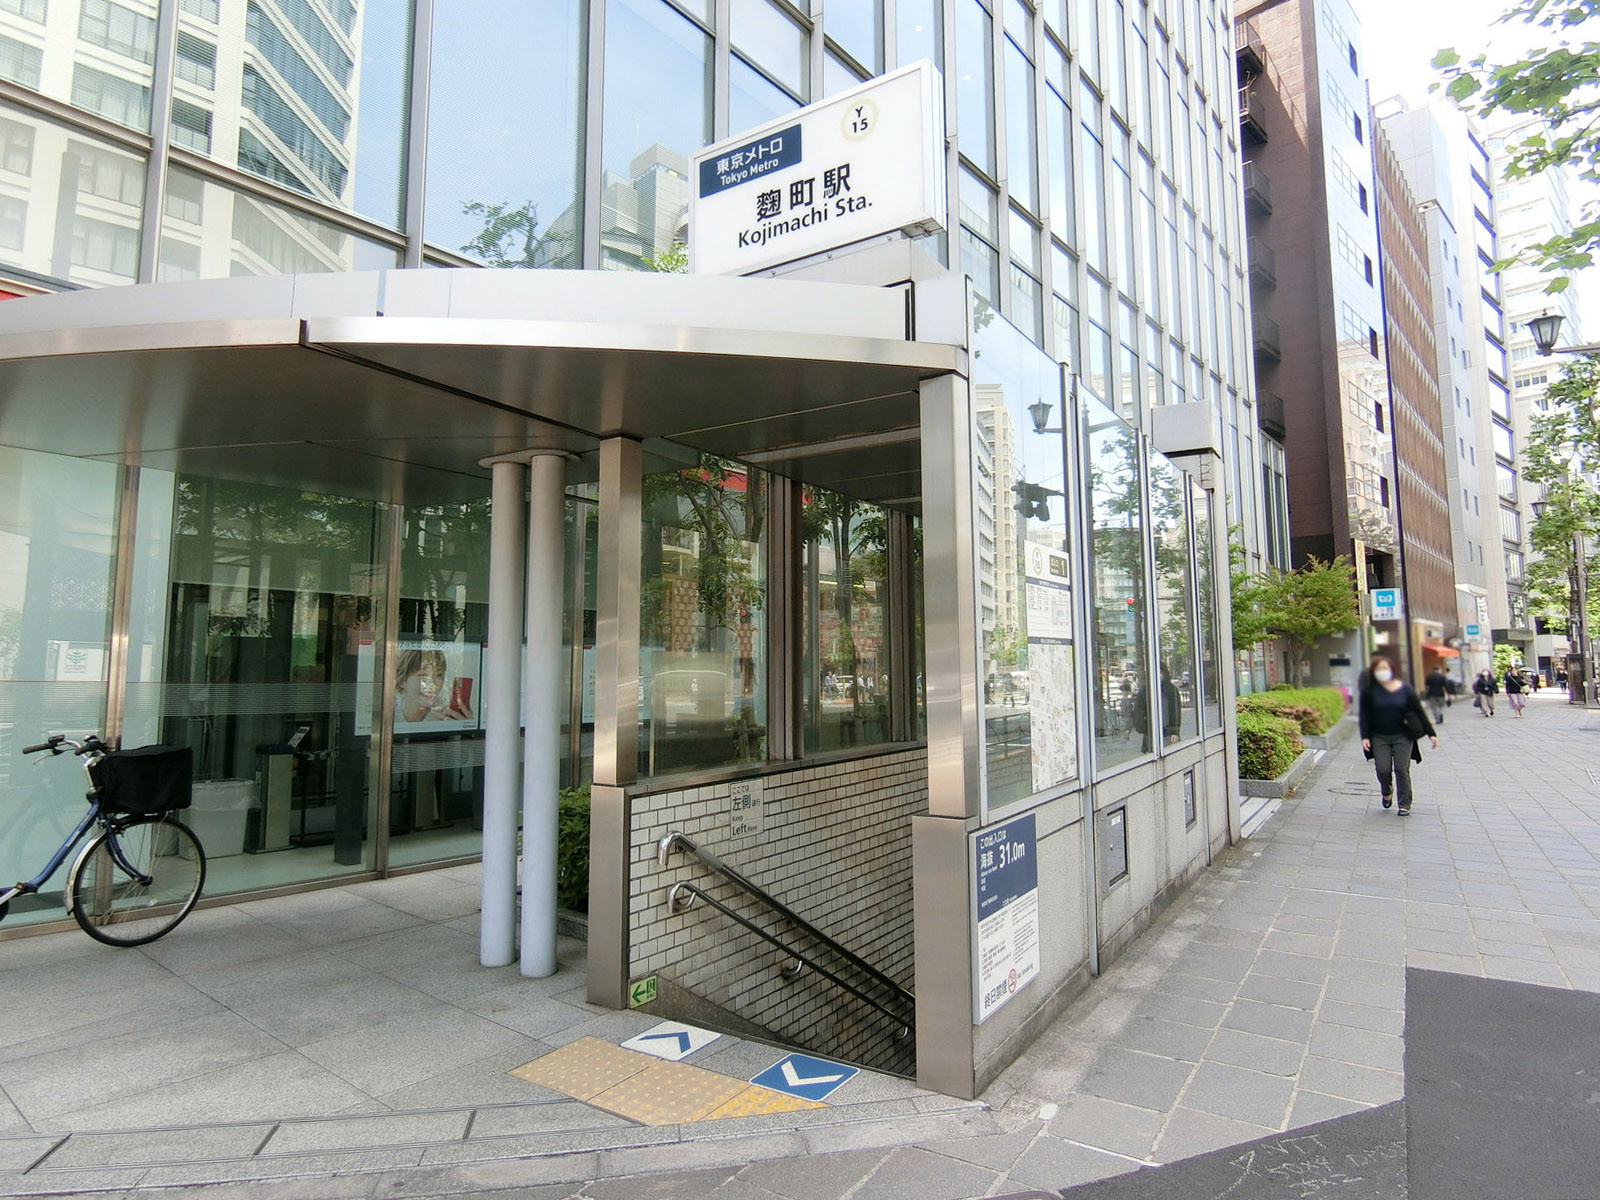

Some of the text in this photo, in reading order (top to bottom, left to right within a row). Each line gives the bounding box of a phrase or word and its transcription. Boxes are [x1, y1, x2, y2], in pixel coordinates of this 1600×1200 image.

[855, 106, 863, 118] Y
[852, 118, 868, 133] 15
[716, 137, 783, 176] 東京メトロ
[720, 158, 779, 186] Tokyo Metro
[738, 194, 873, 248] Kojimachi Sta.
[732, 794, 751, 811] 左側
[732, 822, 747, 836] Left
[999, 841, 1026, 869] 31.0m
